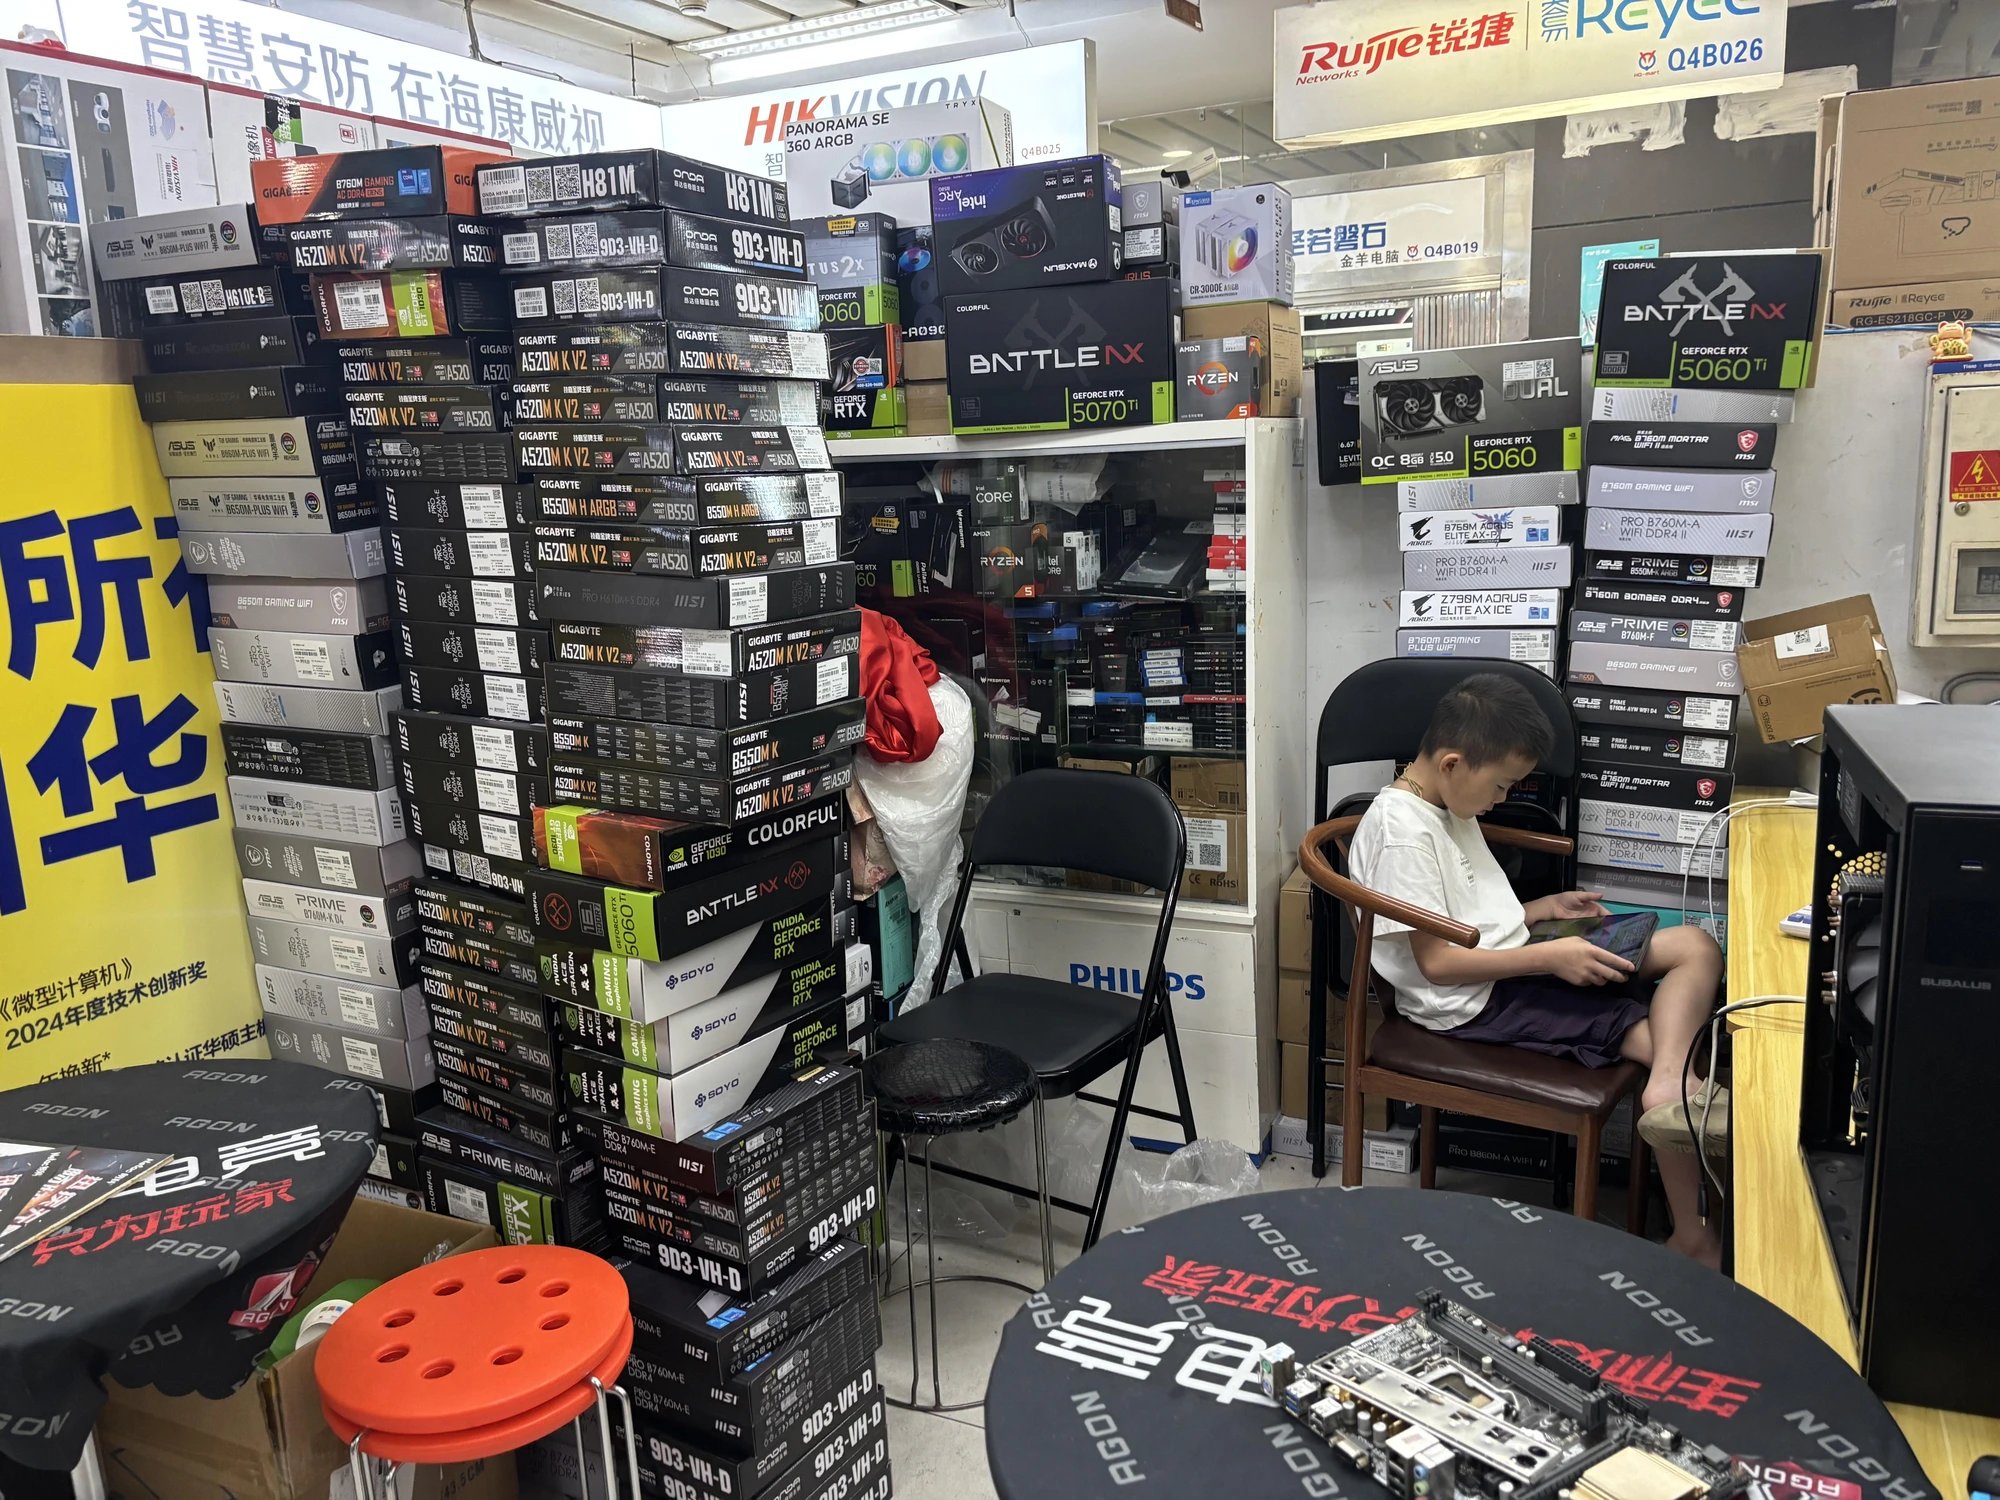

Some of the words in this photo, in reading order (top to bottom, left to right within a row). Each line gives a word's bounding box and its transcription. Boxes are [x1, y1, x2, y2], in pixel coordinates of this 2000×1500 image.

[1298, 27, 1424, 74] Ruijie
[1426, 12, 1518, 56] 锐捷
[1668, 37, 1763, 72] Q4B026
[127, 2, 374, 113] 智慧安防
[386, 61, 605, 153] 在海康威视
[1296, 69, 1358, 85] Networks
[945, 99, 978, 110] TRYX
[786, 117, 868, 137] PANORAMA
[872, 112, 890, 127] SE
[786, 139, 811, 153] 360
[815, 133, 854, 149] ARGB
[1021, 144, 1061, 159] Q4B025
[336, 179, 363, 189] B760M
[364, 176, 394, 188] GAMING
[673, 168, 705, 182] ONDA
[724, 172, 775, 219] H81M
[938, 191, 962, 203] ARC
[959, 195, 987, 212] intel
[291, 229, 333, 240] GIGABYTE
[106, 240, 134, 253] ASUS
[600, 234, 658, 257] 9D3-VH-D
[731, 228, 803, 268] 9D3-VH-D
[1425, 242, 1479, 258] Q4B019
[295, 243, 337, 267] A520M
[350, 243, 367, 264] V2
[1341, 250, 1400, 269] 金羊电脑
[1043, 261, 1087, 273] MAXSUN
[1613, 262, 1656, 270] COLORFUL
[320, 283, 332, 332] COLORFUL
[955, 303, 991, 313] COLORFUL
[1952, 309, 1967, 320] V2
[1681, 346, 1726, 356] GEFORCE
[1728, 346, 1748, 355] RTX
[1368, 359, 1420, 376] ASUS
[1678, 358, 1751, 381] 5060
[1753, 359, 1767, 372] Ti
[1187, 371, 1239, 386] RYZEN
[1072, 389, 1109, 400] GEFORCE
[1110, 388, 1124, 397] RTX
[1503, 377, 1569, 401] DUAL
[1072, 399, 1127, 426] 5070
[1128, 400, 1139, 411] Ti
[1239, 405, 1248, 416] 5
[518, 431, 559, 441] GIGABYTE
[1473, 437, 1513, 448] GEFORCE
[1514, 435, 1533, 445] RTX
[1634, 435, 1667, 443] B760M
[1668, 435, 1709, 443] MORTAR
[521, 446, 562, 467] A520M
[563, 446, 572, 466] K
[573, 446, 591, 466] V2
[1371, 455, 1396, 469] OC
[1472, 446, 1537, 471] 5060
[539, 480, 581, 490] GIGABYTE
[1601, 481, 1633, 491] B760M
[1634, 482, 1673, 492] GAMING
[1674, 484, 1694, 492] WIFI
[975, 489, 1013, 504] CORE
[225, 503, 272, 516] B650M-PLUS
[273, 504, 289, 516] WIFI
[542, 497, 578, 515] B550M
[589, 498, 617, 517] ARGB
[1444, 522, 1477, 532] B760M
[1480, 521, 1514, 531] AORUS
[1444, 531, 1470, 540] ELITE
[979, 555, 1024, 568] RYZEN
[1435, 557, 1457, 568] PRO
[1460, 556, 1509, 567] B760M-A
[1631, 558, 1680, 569] PRIME
[1435, 568, 1457, 577] WIFI
[1459, 567, 1489, 577] DDR4
[0, 505, 212, 682] 所
[1441, 594, 1484, 604] Z790M
[1485, 593, 1528, 603] AORUS
[1585, 591, 1620, 600] B760M
[1624, 593, 1667, 603] BOMBER
[1671, 595, 1700, 605] DDR4
[1440, 606, 1472, 616] ELITE
[1473, 605, 1492, 615] AX
[1493, 605, 1513, 614] ICE
[1611, 619, 1669, 632] PRIME
[1408, 636, 1441, 645] B760M
[1443, 636, 1481, 645] GAMING
[1621, 630, 1656, 641] B760M-F
[1408, 644, 1434, 653] PLUS
[1436, 644, 1457, 653] WIFI
[1606, 660, 1638, 669] B650M
[1639, 662, 1676, 671] GAMING
[1677, 665, 1698, 674] WIFI
[0, 694, 220, 915] 华
[748, 804, 838, 847] COLORFUL
[690, 834, 733, 854] GEFORCE
[692, 851, 704, 865] GT
[706, 846, 727, 861] 1030
[667, 861, 688, 872] NVIDIA
[772, 912, 805, 932] NVIDIA
[774, 918, 821, 946] GEFORCE
[774, 942, 796, 960] RTX
[679, 962, 715, 983] SOYO
[1070, 963, 1206, 1000] PHILPS
[5, 960, 208, 1051] 2024年度技术创新奖
[183, 1069, 269, 1086] AGON
[459, 1144, 512, 1173] PRIME
[514, 1160, 553, 1186] A520M-K
[809, 1184, 877, 1252] 9D3-VH-D
[1241, 1212, 1319, 1276] AGON
[657, 1243, 742, 1293] 9D3-VH-D
[1599, 1270, 1715, 1347] AGON
[801, 1368, 874, 1444] 9D3-VH-D
[1070, 1390, 1146, 1486] AGON
